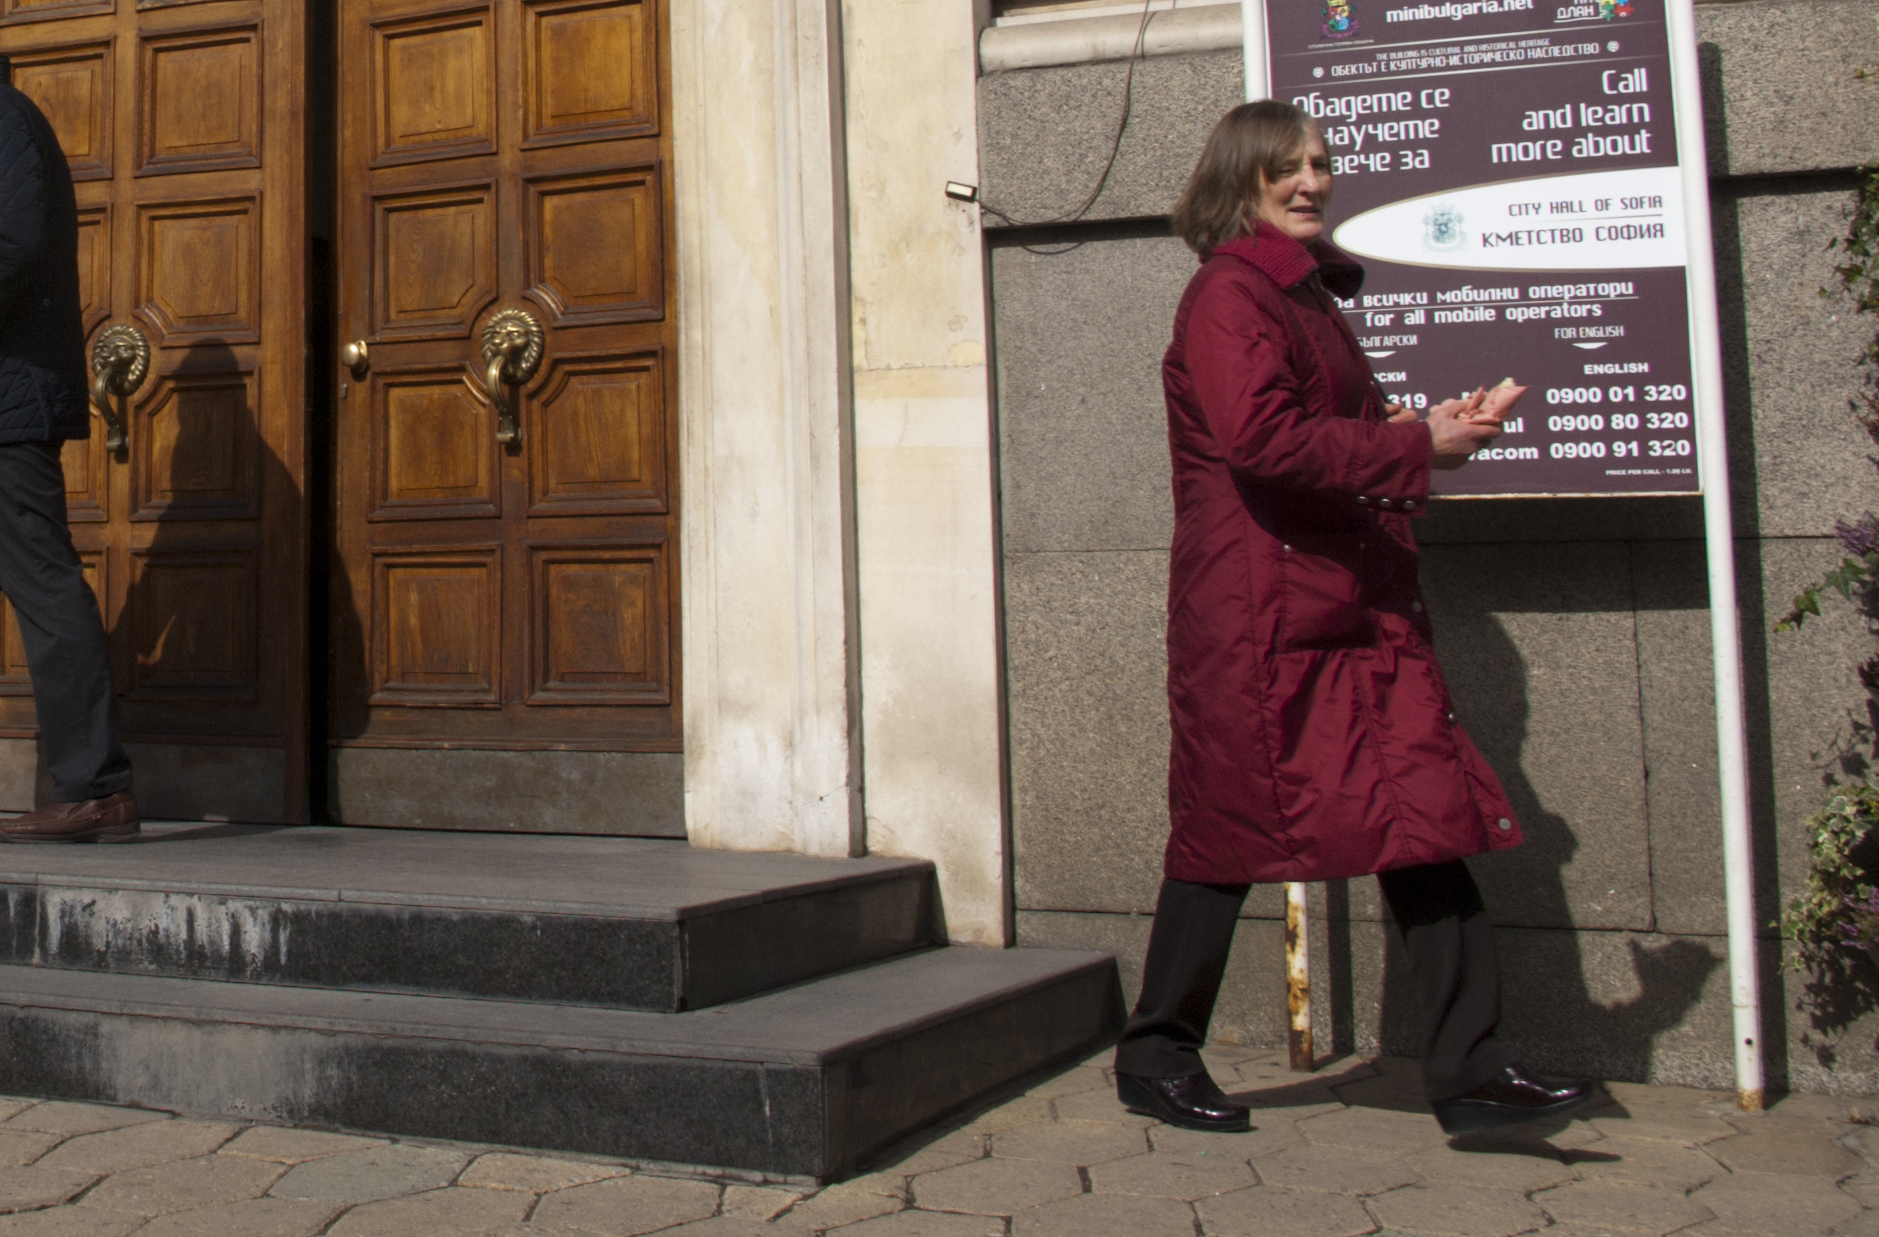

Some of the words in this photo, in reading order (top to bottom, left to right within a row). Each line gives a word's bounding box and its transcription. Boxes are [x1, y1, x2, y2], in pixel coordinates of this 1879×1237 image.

[1556, 5, 1594, 19] ДЛАН
[1331, 62, 1378, 77] ОБЕКТЪТ
[1527, 42, 1601, 59] НАСЛЕДСТВО
[1376, 53, 1388, 61] THE
[1390, 50, 1420, 60] BUILDING
[1428, 46, 1461, 56] CULTURAL
[1463, 44, 1478, 53] AND
[1479, 41, 1517, 51] HISTORICAL
[1518, 38, 1551, 48] HERITAGE
[1602, 67, 1648, 95] Call
[1420, 88, 1451, 109] се
[1522, 104, 1573, 131] and
[1580, 103, 1650, 127] learn
[1491, 139, 1563, 163] more
[1571, 129, 1652, 158] about
[1331, 152, 1391, 175] вече
[1399, 149, 1431, 170] за
[1508, 202, 1541, 217] CITY
[1549, 200, 1587, 214] HALL
[1594, 198, 1612, 212] OF
[1620, 195, 1663, 210] SOFIA
[1481, 227, 1584, 248] КМЕТСТВО
[1595, 223, 1665, 242] СОФИЯ
[1363, 292, 1428, 308] всички
[1436, 285, 1519, 303] мобилни
[1528, 281, 1634, 300] оператори
[1365, 311, 1395, 327] for
[1404, 309, 1425, 325] all
[1434, 306, 1496, 324] mobile
[1505, 302, 1603, 323] operators
[1554, 327, 1577, 339] FOR
[1579, 325, 1625, 338] ENGLISH
[1583, 362, 1650, 375] ENGLISH
[1546, 387, 1602, 404] 0900
[1609, 386, 1635, 402] 01
[1644, 384, 1687, 402] 320
[1548, 414, 1604, 432] 0900
[1611, 413, 1639, 430] 80
[1646, 412, 1689, 429] 320
[1549, 442, 1606, 459] 0900
[1612, 441, 1639, 457] 91
[1647, 439, 1691, 457] 320
